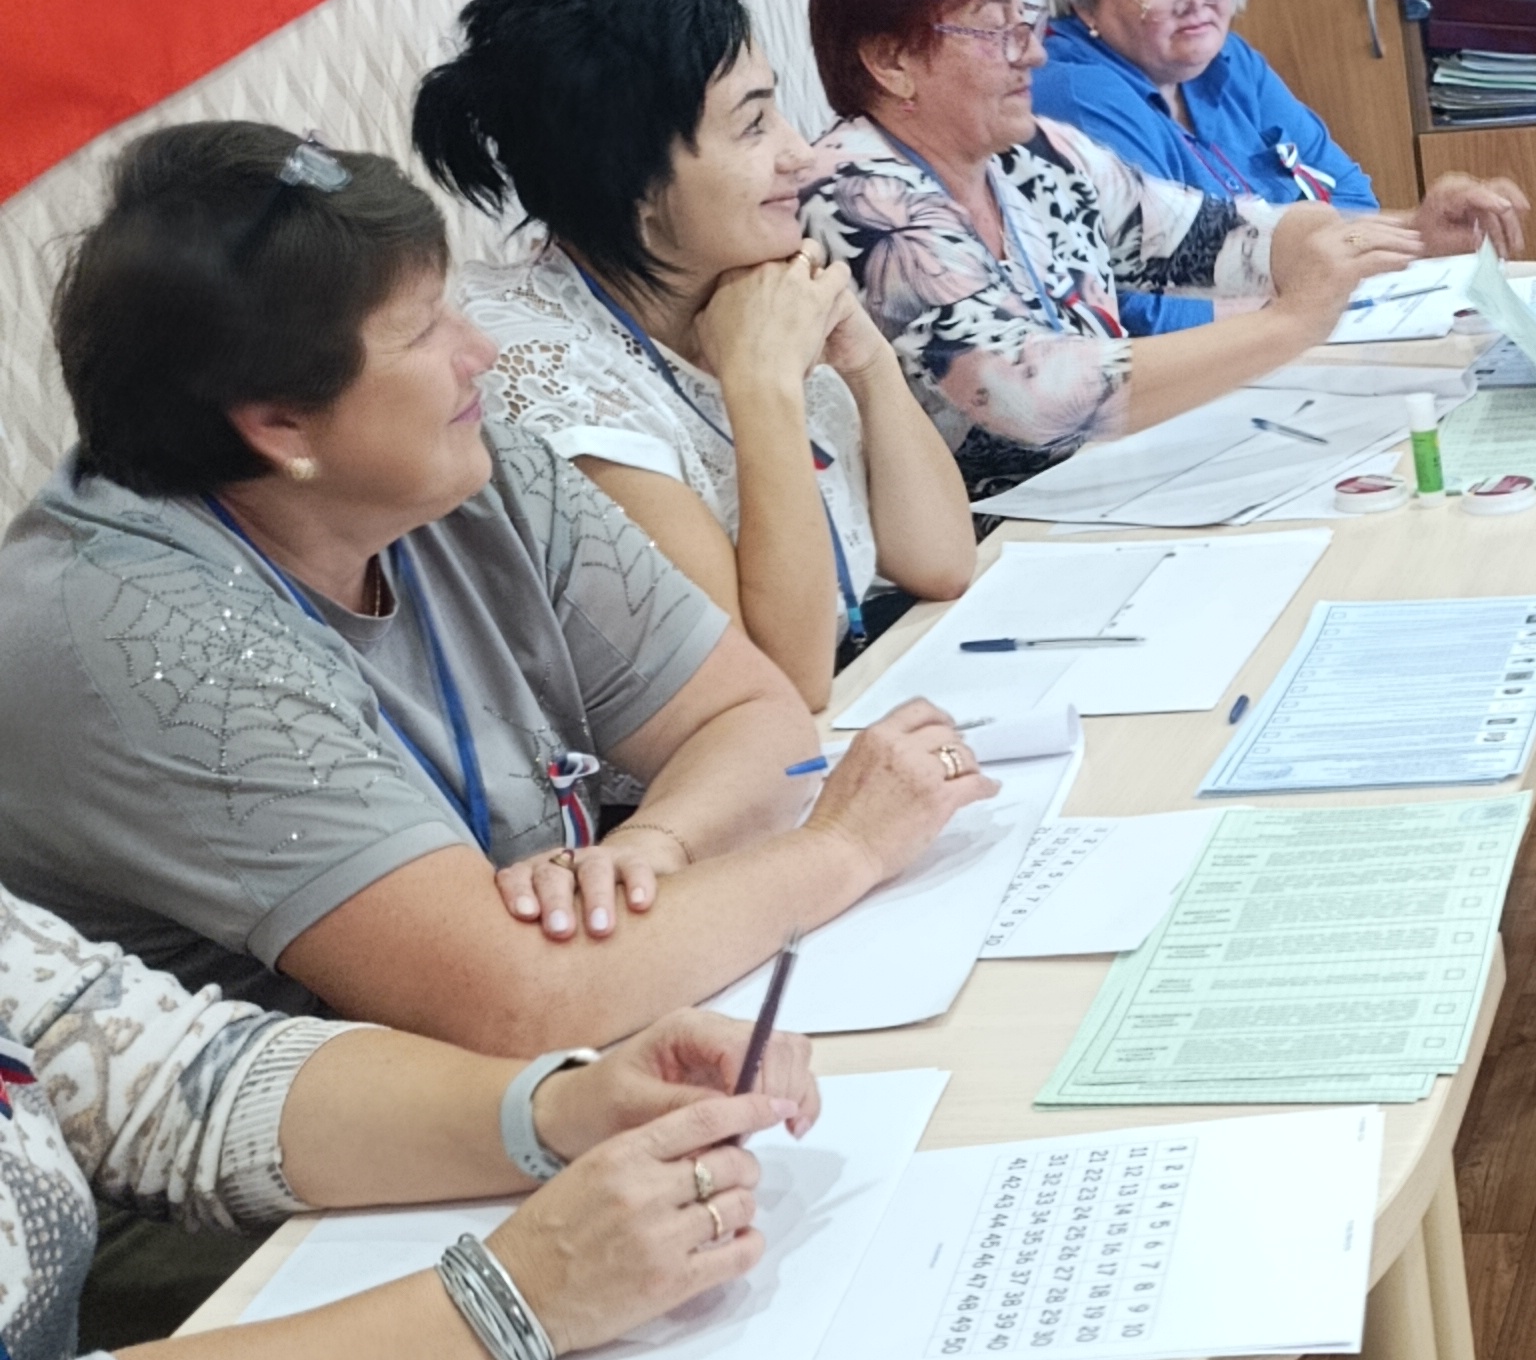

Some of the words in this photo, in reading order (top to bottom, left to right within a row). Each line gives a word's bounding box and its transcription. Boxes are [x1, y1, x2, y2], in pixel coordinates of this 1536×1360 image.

[1089, 1150, 1109, 1163] 21
[1129, 1147, 1148, 1158] 11
[1008, 1157, 1028, 1170] 41
[1048, 1154, 1069, 1166] 31
[1083, 1168, 1103, 1182] 22
[1123, 1165, 1143, 1177] 12
[1002, 1176, 1022, 1189] 42
[1042, 1172, 1062, 1186] 32
[1077, 1186, 1098, 1201] 23
[1118, 1184, 1139, 1196] 13
[994, 1194, 1015, 1209] 43
[1035, 1191, 1057, 1205] 33
[1072, 1206, 1093, 1220] 24
[1114, 1203, 1134, 1215] 14
[989, 1214, 1008, 1228] 44
[1030, 1210, 1051, 1224] 34
[1107, 1222, 1128, 1236] 15
[1150, 1220, 1170, 1229] 5
[980, 1233, 1002, 1248] 45
[1022, 1230, 1045, 1245] 35
[1065, 1226, 1087, 1241] 25
[1101, 1242, 1123, 1256] 16
[1144, 1241, 1164, 1249] 6
[972, 1253, 995, 1268] 46
[1016, 1250, 1038, 1265] 36
[1058, 1246, 1081, 1261] 26
[1096, 1262, 1118, 1276] 17
[1140, 1261, 1161, 1269] 7
[966, 1273, 988, 1288] 47
[1009, 1270, 1031, 1285] 37
[1053, 1266, 1075, 1281] 27
[1089, 1284, 1112, 1298] 18
[1134, 1282, 1155, 1291] 8
[958, 1295, 980, 1311] 48
[1001, 1291, 1024, 1307] 38
[1045, 1288, 1069, 1304] 28
[1083, 1306, 1106, 1319] 19
[1128, 1304, 1150, 1313] 9
[950, 1316, 973, 1332] 49
[994, 1313, 1018, 1329] 39
[1039, 1309, 1062, 1325] 29
[1076, 1326, 1100, 1342] 20
[1121, 1324, 1144, 1337] 10
[941, 1337, 966, 1354] 50
[986, 1334, 1010, 1350] 40
[1030, 1330, 1056, 1347] 30
